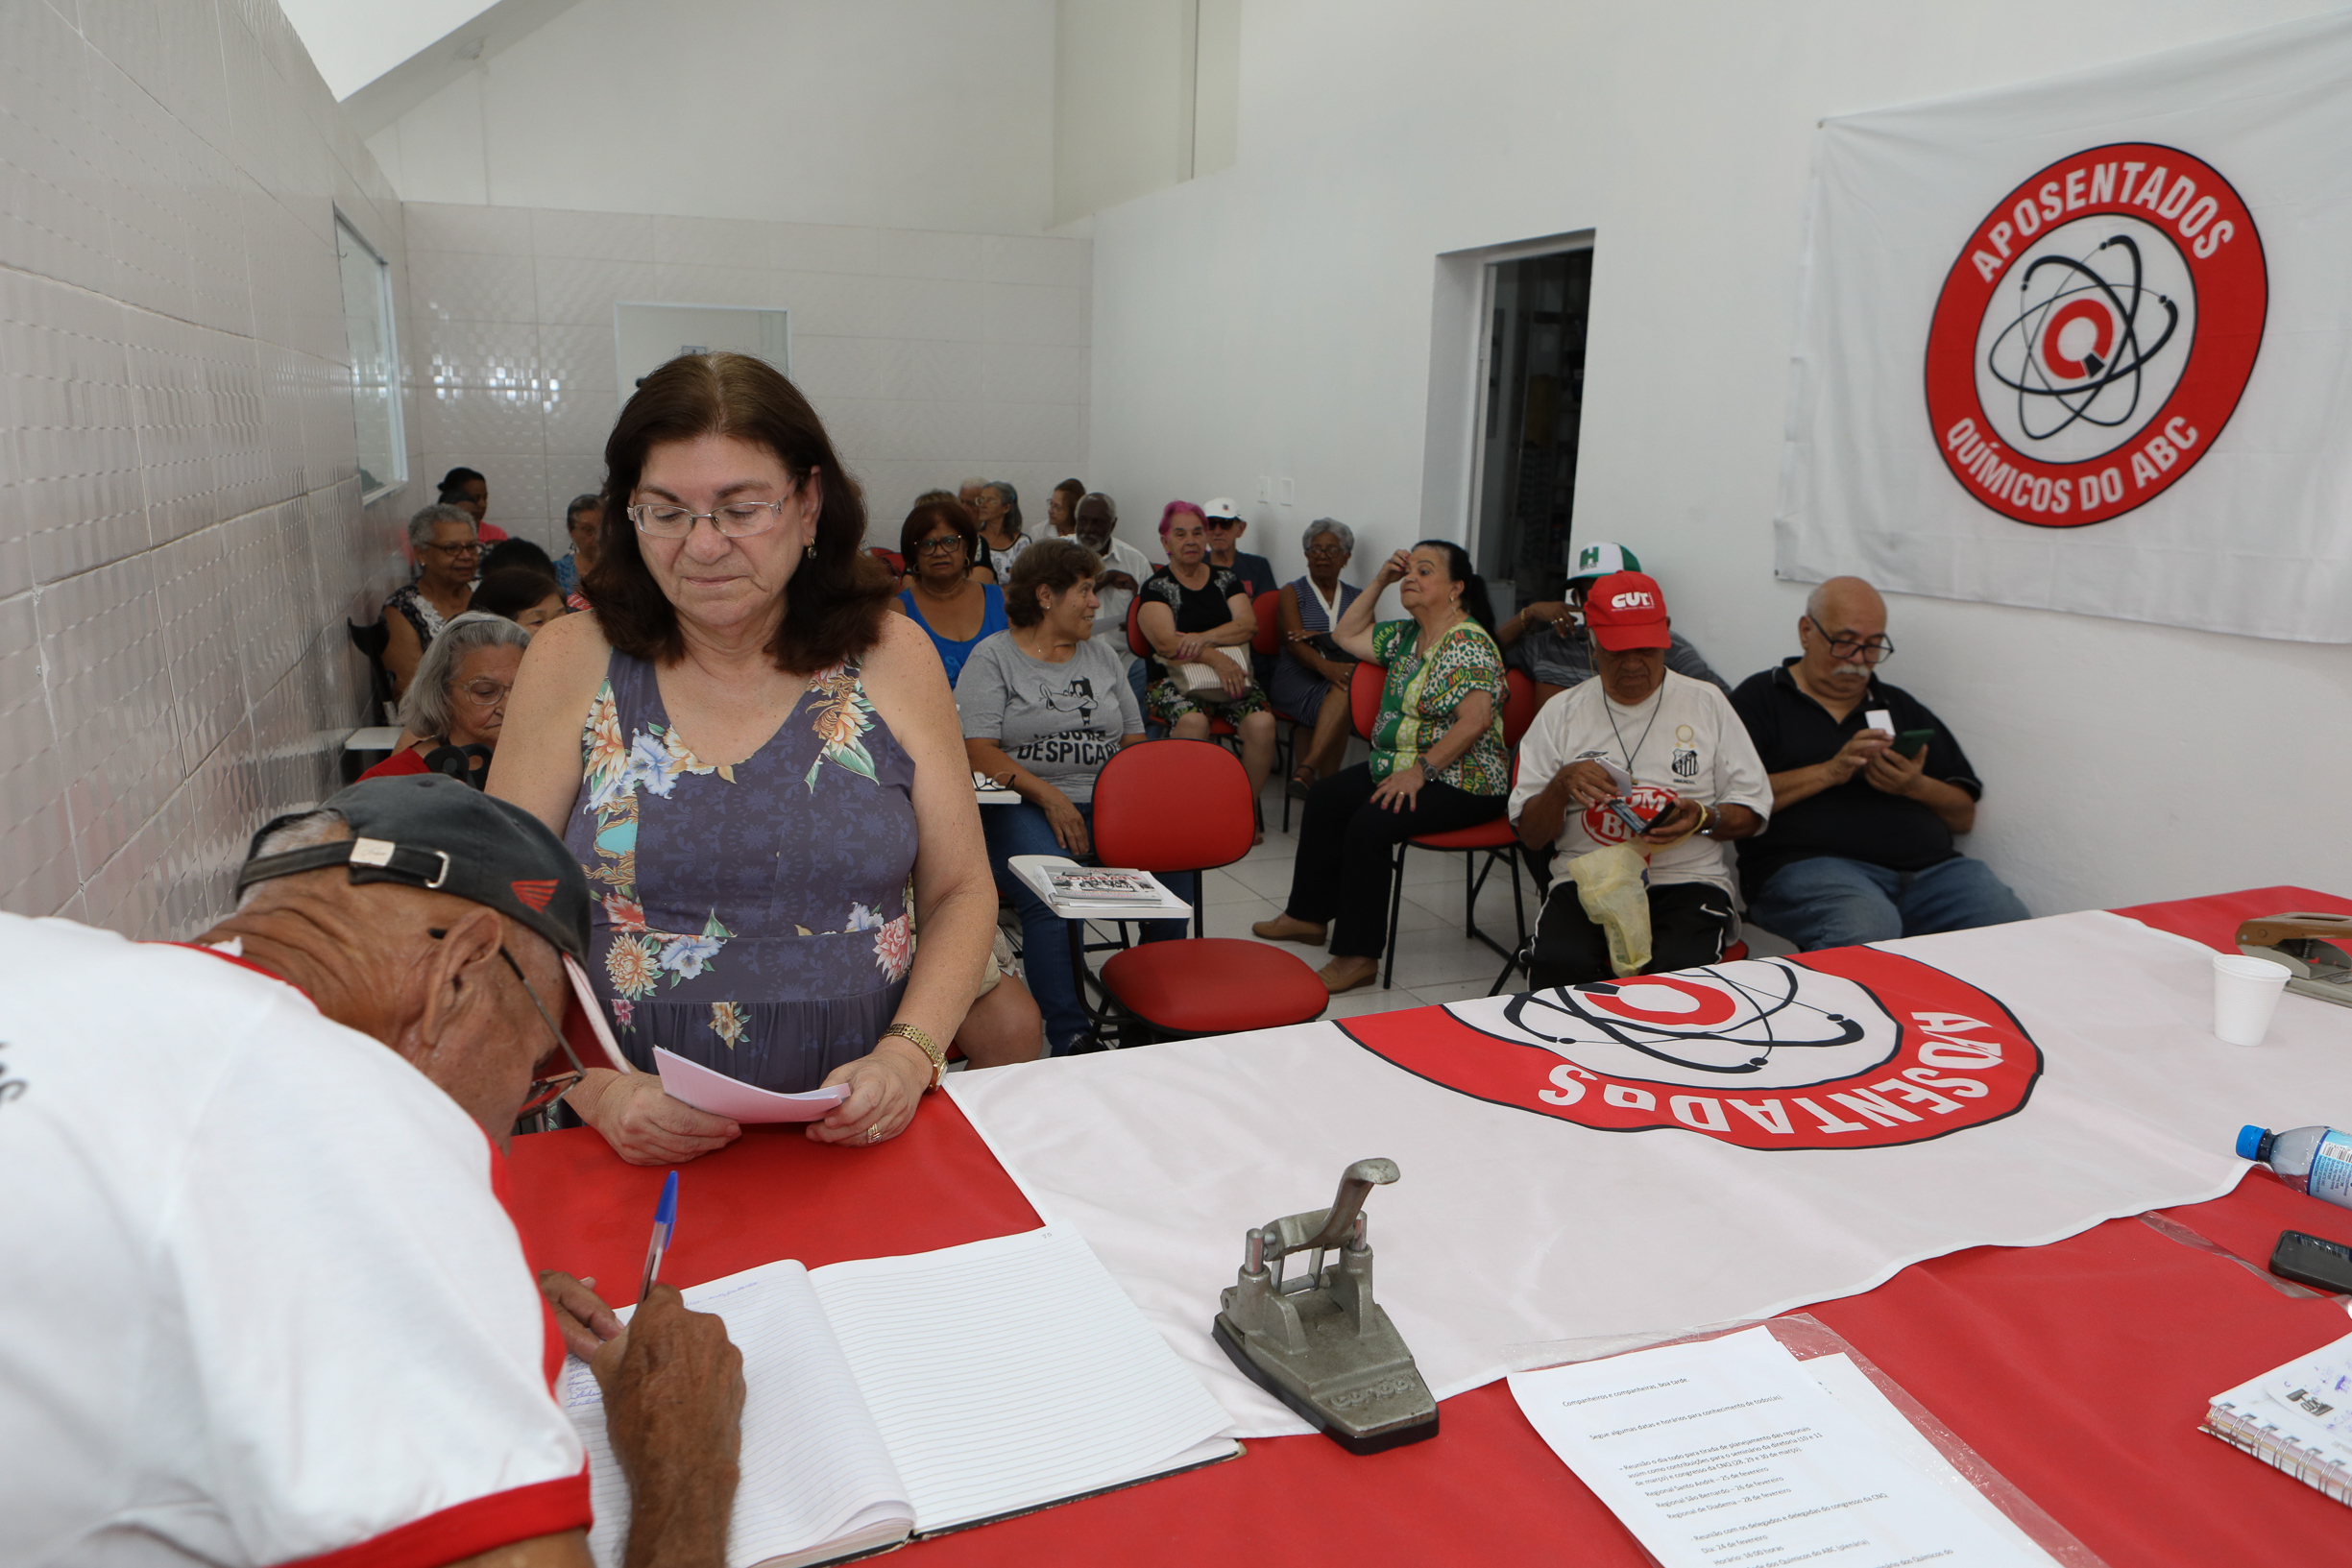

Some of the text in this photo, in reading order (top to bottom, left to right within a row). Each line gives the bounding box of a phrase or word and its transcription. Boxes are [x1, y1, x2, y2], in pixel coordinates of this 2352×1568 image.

[1971, 161, 2235, 283] APOSENTADOS
[1946, 416, 2198, 514] QUÍMICOS DO ABC
[1611, 591, 1651, 609] CUT
[1563, 1395, 1608, 1407] Companheiros
